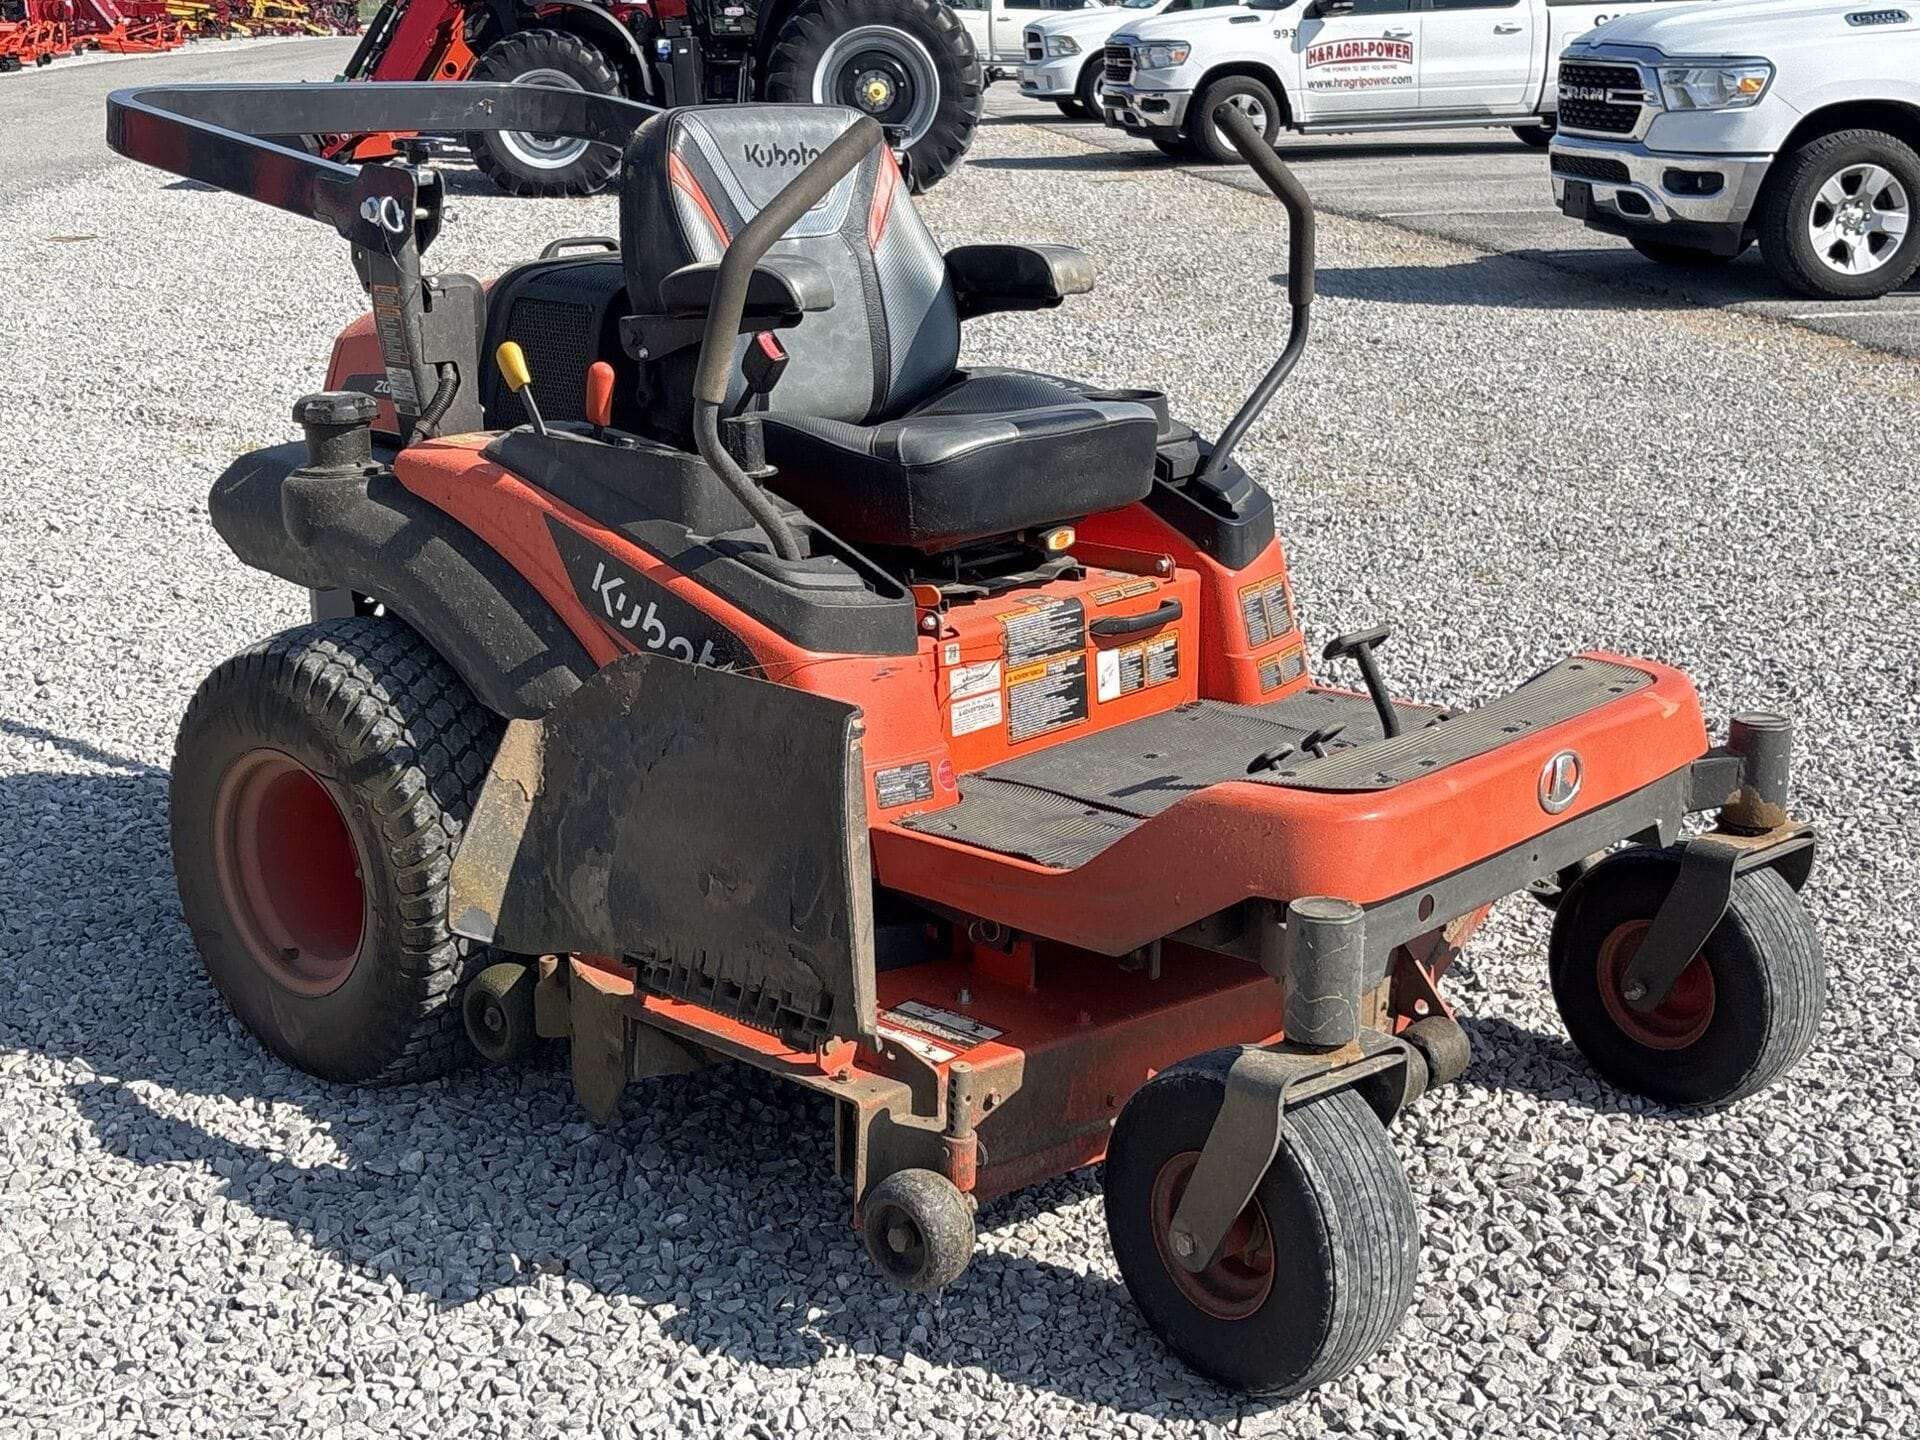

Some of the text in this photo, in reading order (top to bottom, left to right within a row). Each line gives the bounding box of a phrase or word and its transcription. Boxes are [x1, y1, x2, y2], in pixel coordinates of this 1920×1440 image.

[1273, 28, 1297, 39] 993
[1309, 41, 1410, 65] H&R AGRI-POWER
[1307, 75, 1412, 89] www.hragripower.com
[1566, 86, 1604, 101] RAM
[591, 561, 717, 666] Kubot
